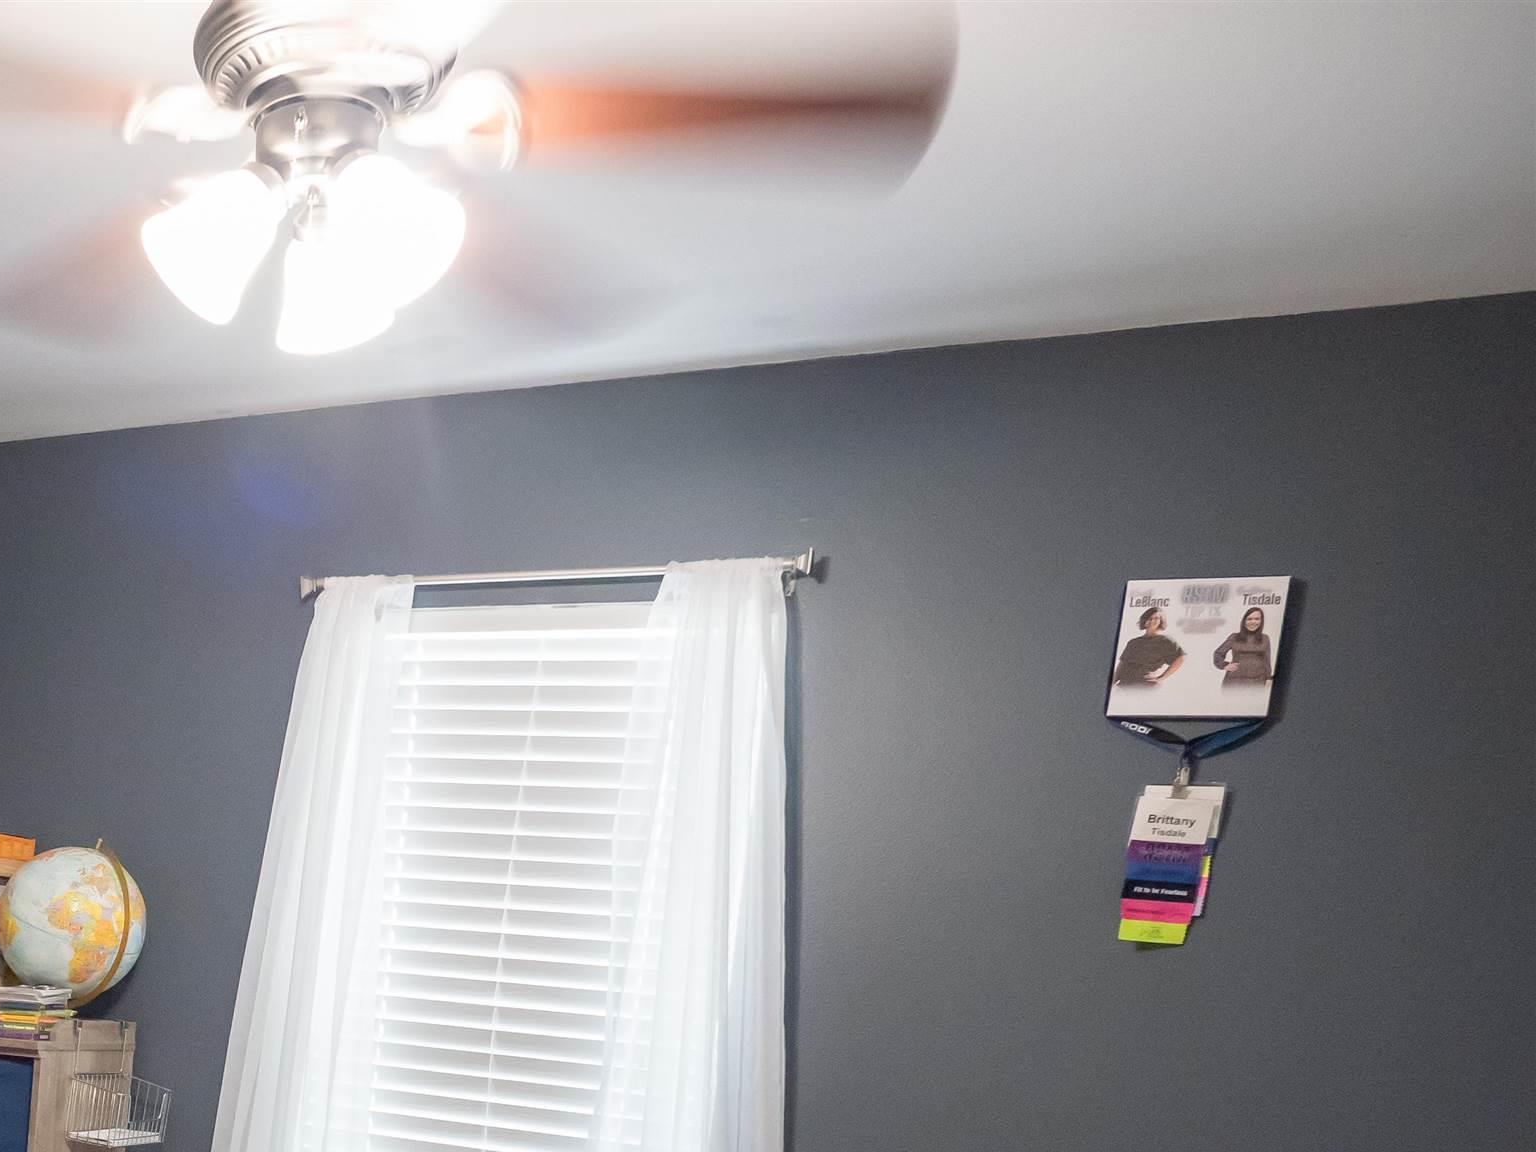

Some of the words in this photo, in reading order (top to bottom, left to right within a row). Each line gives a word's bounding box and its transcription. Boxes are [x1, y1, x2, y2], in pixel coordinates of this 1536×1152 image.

[1129, 596, 1170, 608] LeBlanc
[1242, 592, 1282, 606] Tisdale
[1147, 814, 1196, 828] Brittany
[1151, 827, 1187, 837] Tisdale
